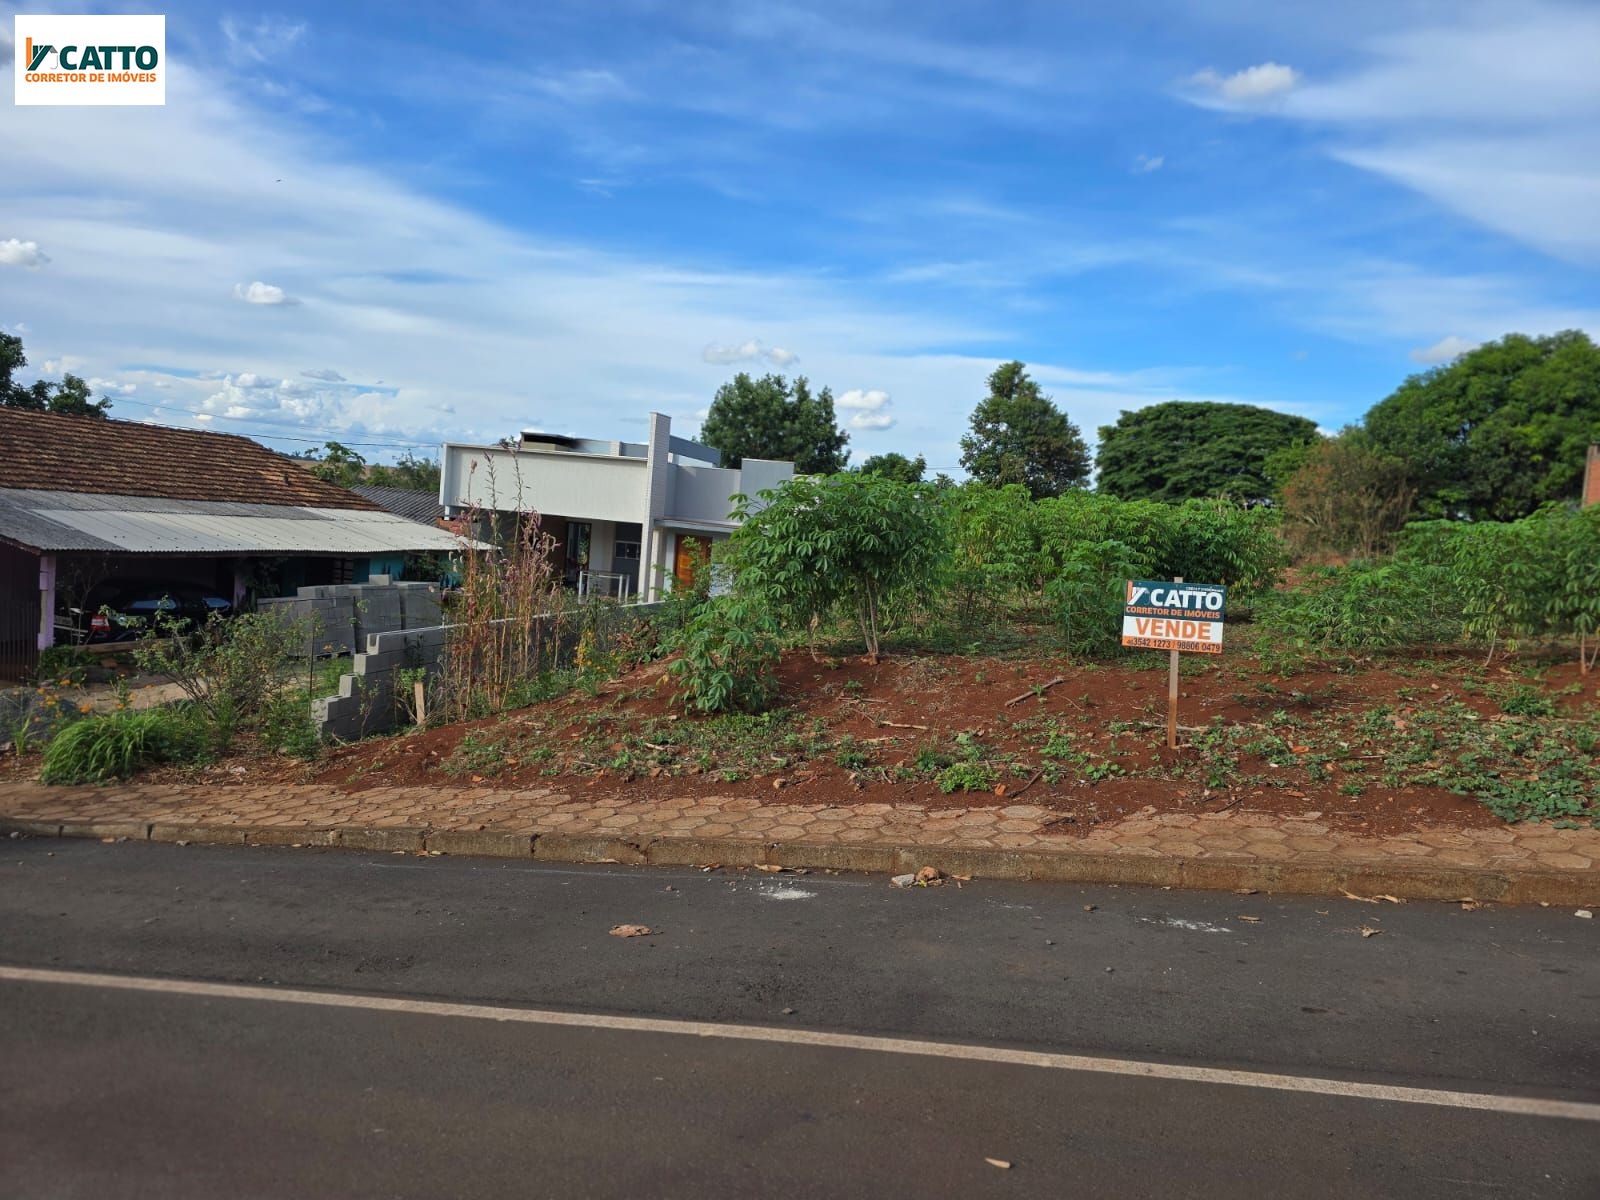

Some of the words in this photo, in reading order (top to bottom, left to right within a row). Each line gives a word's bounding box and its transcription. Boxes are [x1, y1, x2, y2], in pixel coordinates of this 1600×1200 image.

[1150, 588, 1223, 611] CATTO
[1125, 606, 1169, 616] CORRETOR
[1184, 609, 1220, 619] IMÓVEIS
[1135, 618, 1211, 640] VENDE
[1153, 639, 1171, 648] 1273
[1201, 643, 1220, 653] 0479
